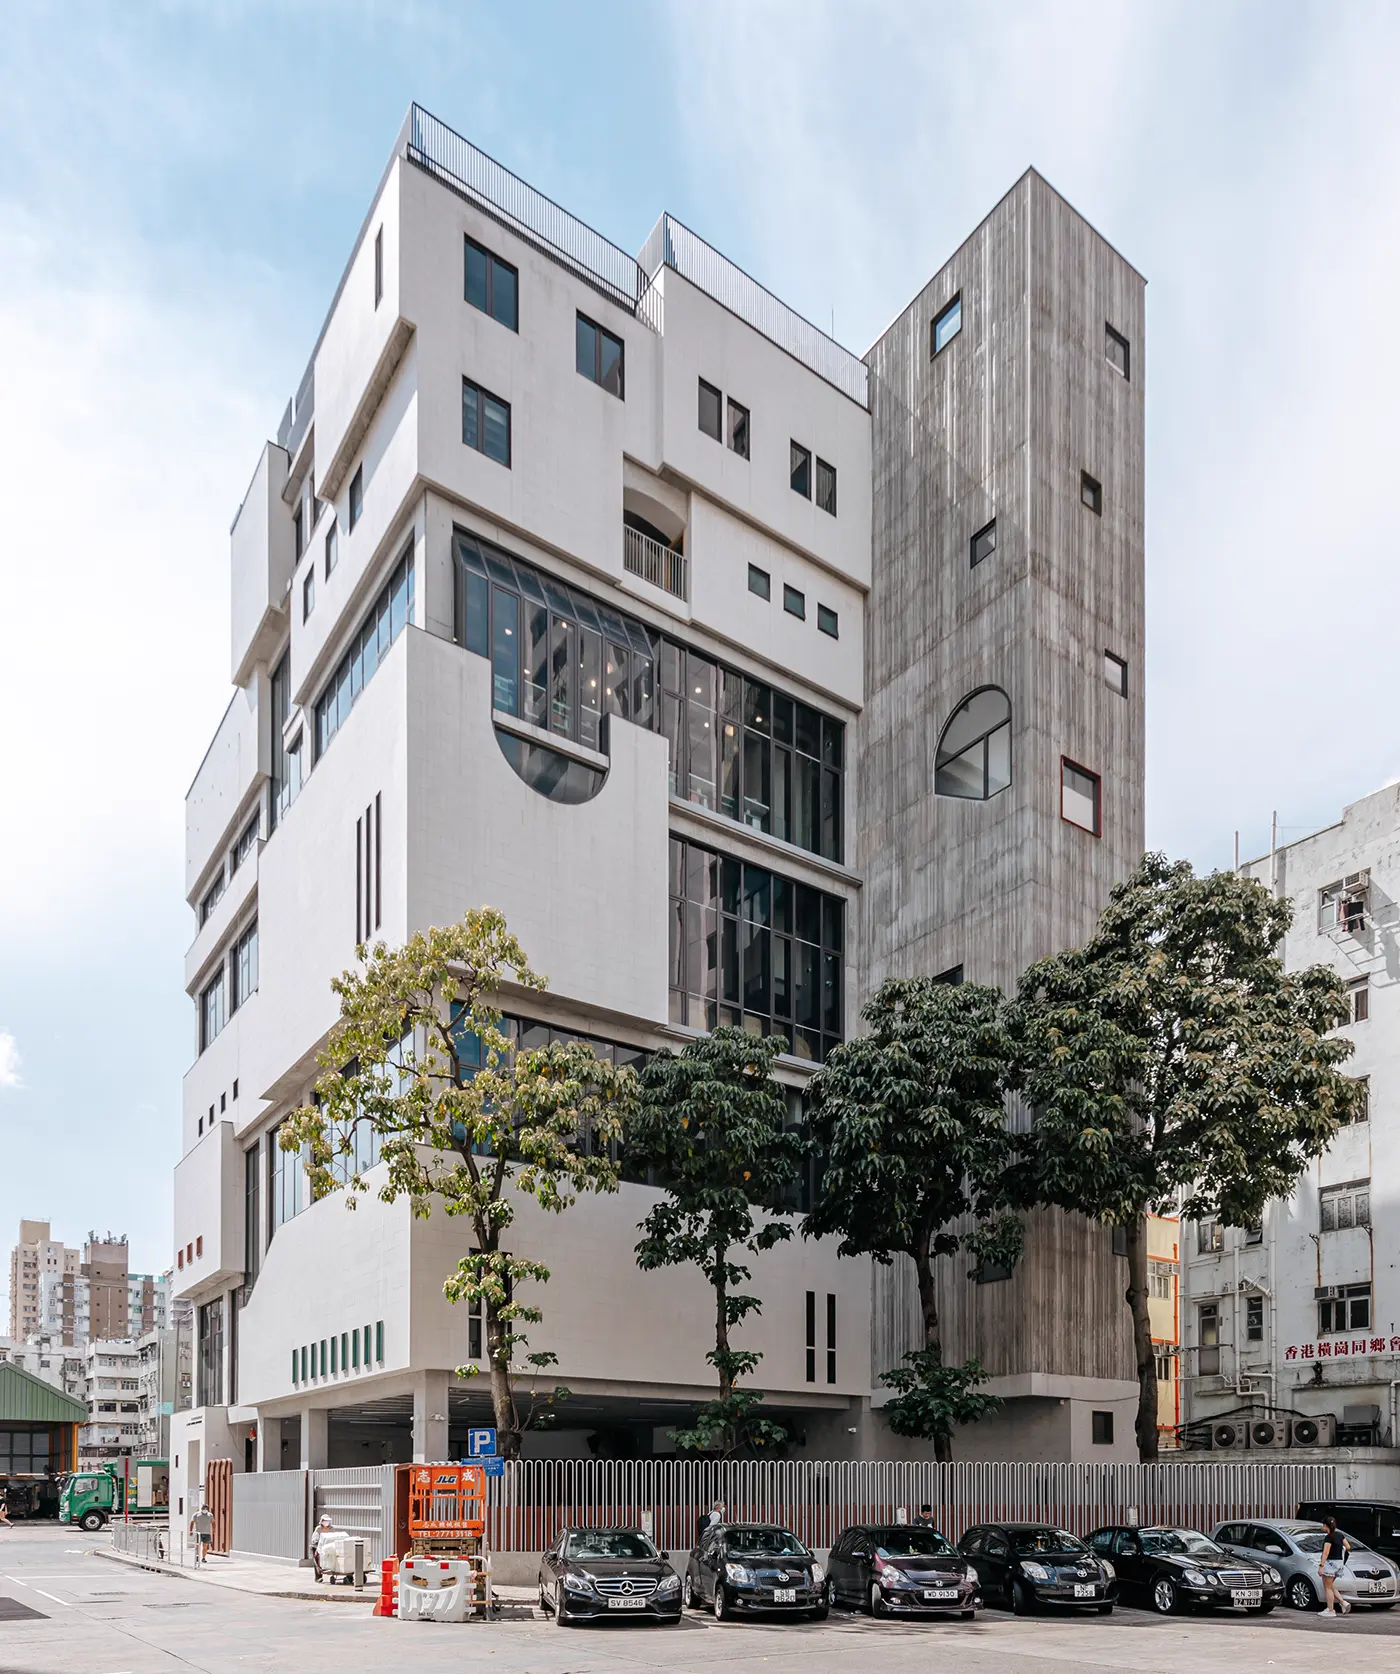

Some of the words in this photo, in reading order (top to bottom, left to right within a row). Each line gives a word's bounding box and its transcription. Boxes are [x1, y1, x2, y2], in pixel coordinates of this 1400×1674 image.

[474, 1431, 490, 1453] P
[417, 1469, 430, 1483] 志
[435, 1475, 457, 1484] JLG
[461, 1468, 475, 1482] 成
